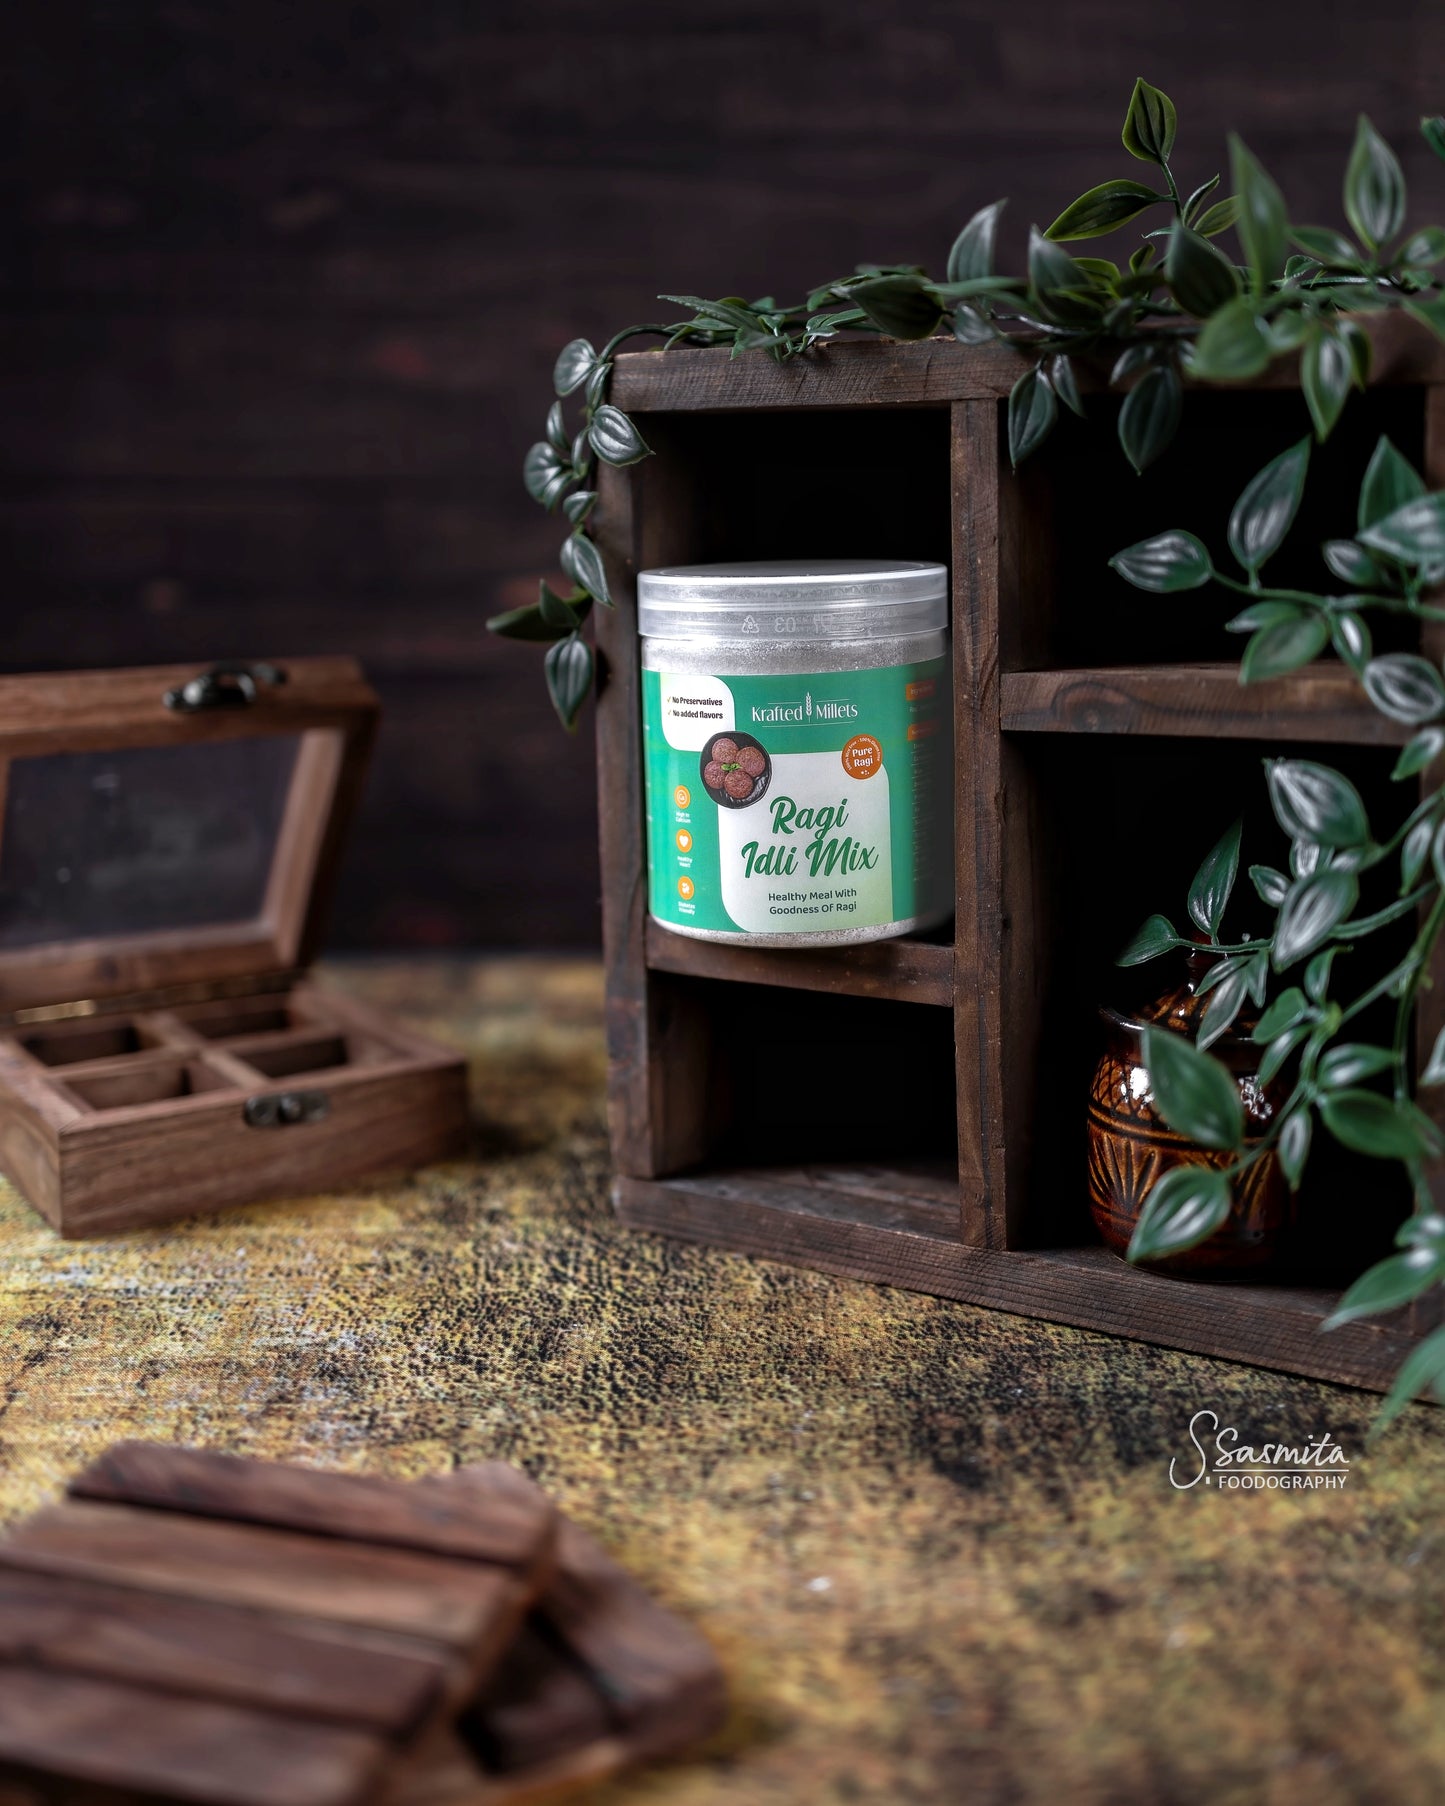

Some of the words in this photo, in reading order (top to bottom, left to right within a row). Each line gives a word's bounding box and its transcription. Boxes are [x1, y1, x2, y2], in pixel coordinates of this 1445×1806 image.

[672, 696, 679, 704] No
[680, 697, 723, 706] Preservatives
[673, 709, 680, 717] No
[681, 710, 698, 718] added
[699, 710, 723, 719] flavors
[752, 705, 803, 722] Krafted
[816, 703, 858, 719] Millets
[852, 747, 873, 757] Pure
[854, 755, 873, 767] Ragi
[769, 796, 849, 840] Ragi
[741, 841, 799, 878] Idli
[804, 836, 879, 877] Mix
[768, 892, 807, 902] Healthy
[809, 890, 833, 900] Meal
[834, 888, 857, 897] With
[769, 905, 819, 915] Goodness
[836, 901, 857, 912] Ragi
